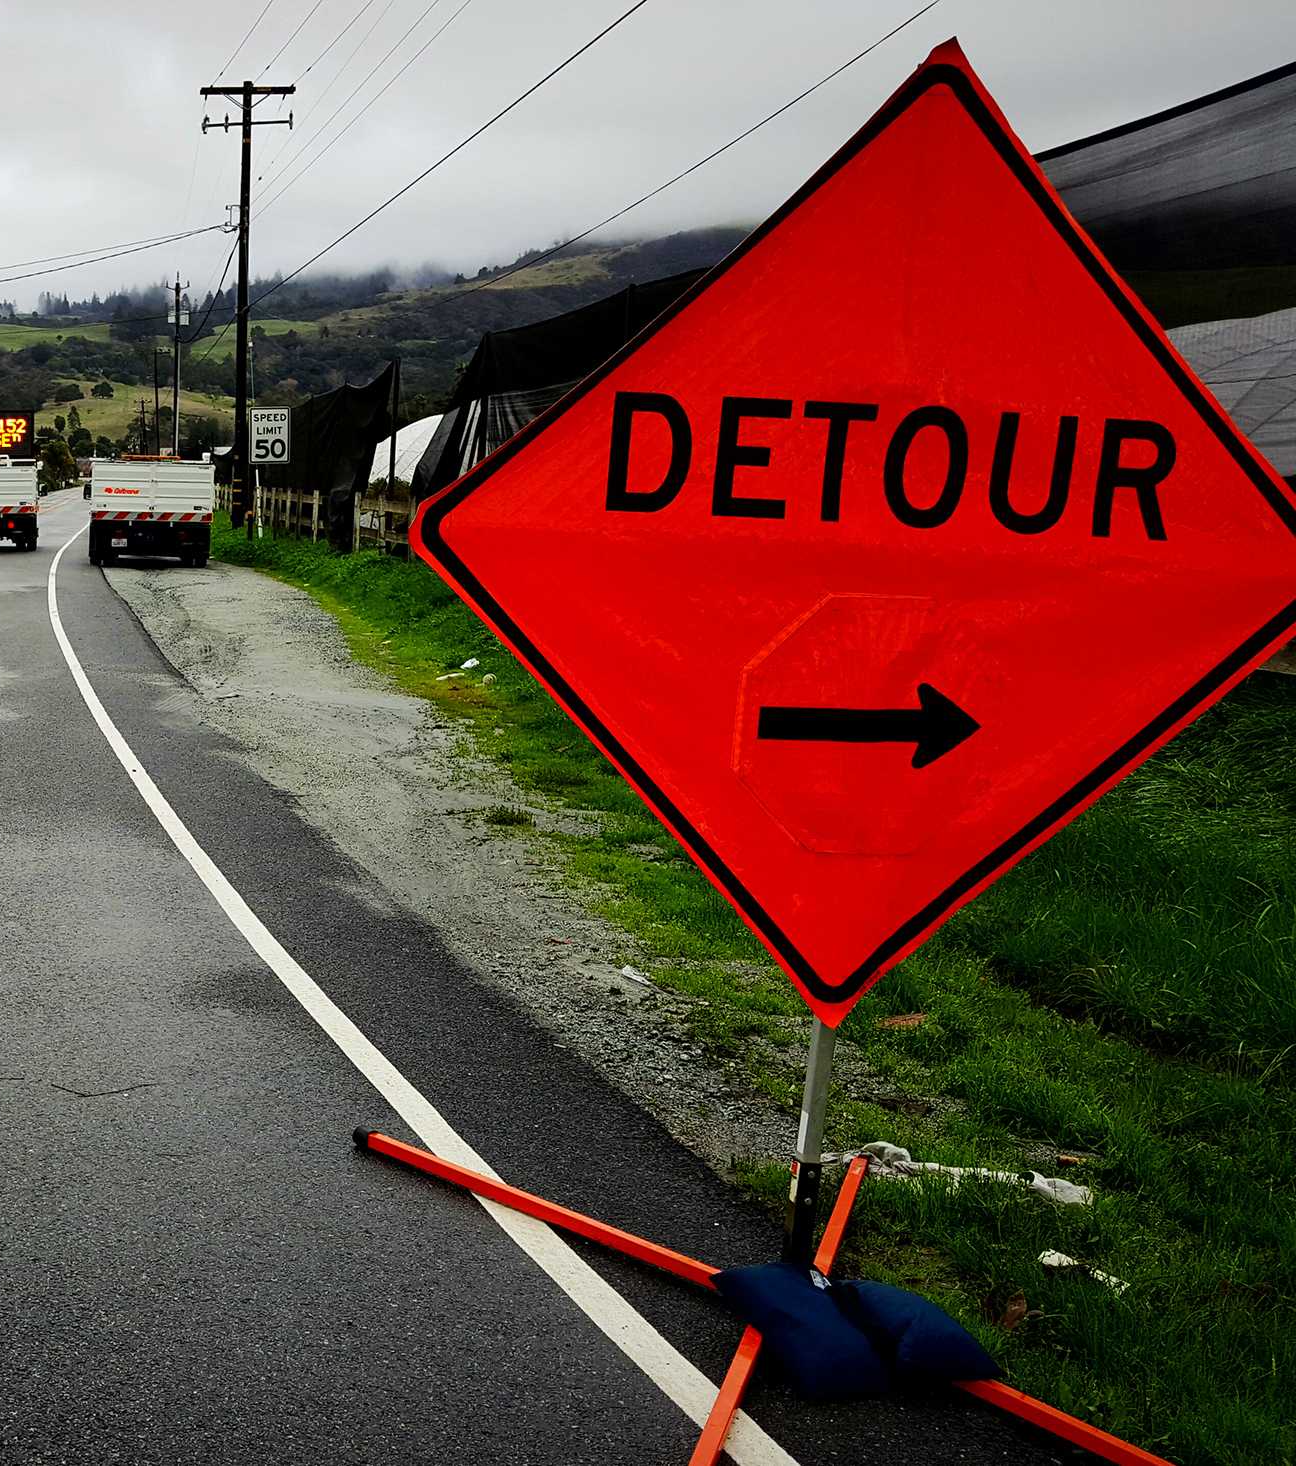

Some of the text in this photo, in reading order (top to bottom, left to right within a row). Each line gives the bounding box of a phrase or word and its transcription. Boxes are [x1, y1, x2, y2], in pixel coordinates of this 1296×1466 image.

[253, 413, 286, 422] SPEED
[256, 426, 283, 435] LIMIT
[254, 438, 286, 459] 50
[606, 392, 1177, 541] DETOUR
